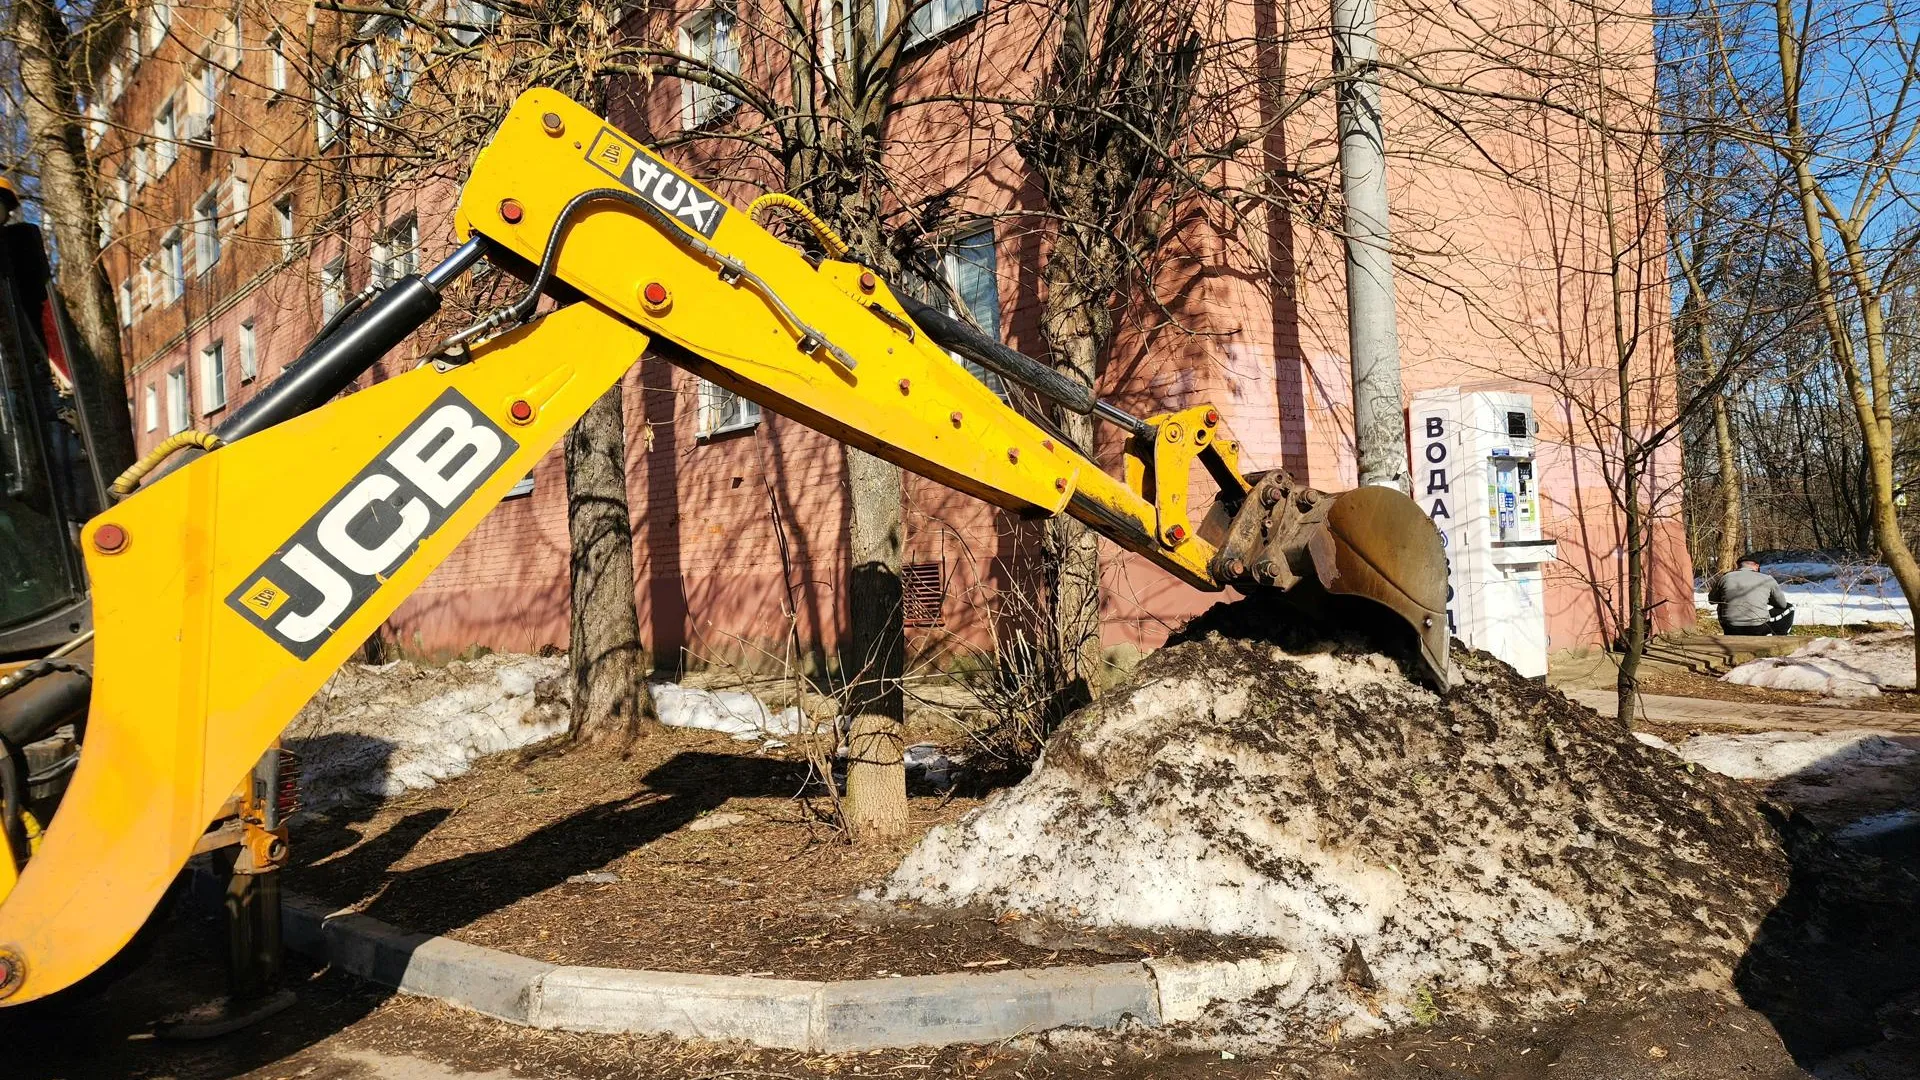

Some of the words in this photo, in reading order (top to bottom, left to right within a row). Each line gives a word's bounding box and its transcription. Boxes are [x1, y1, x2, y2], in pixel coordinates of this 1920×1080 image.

[600, 144, 621, 164] JCB
[631, 156, 716, 232] 4CX
[1425, 416, 1451, 520] ВОДА
[275, 404, 502, 643] JCB
[252, 589, 276, 607] JCB
